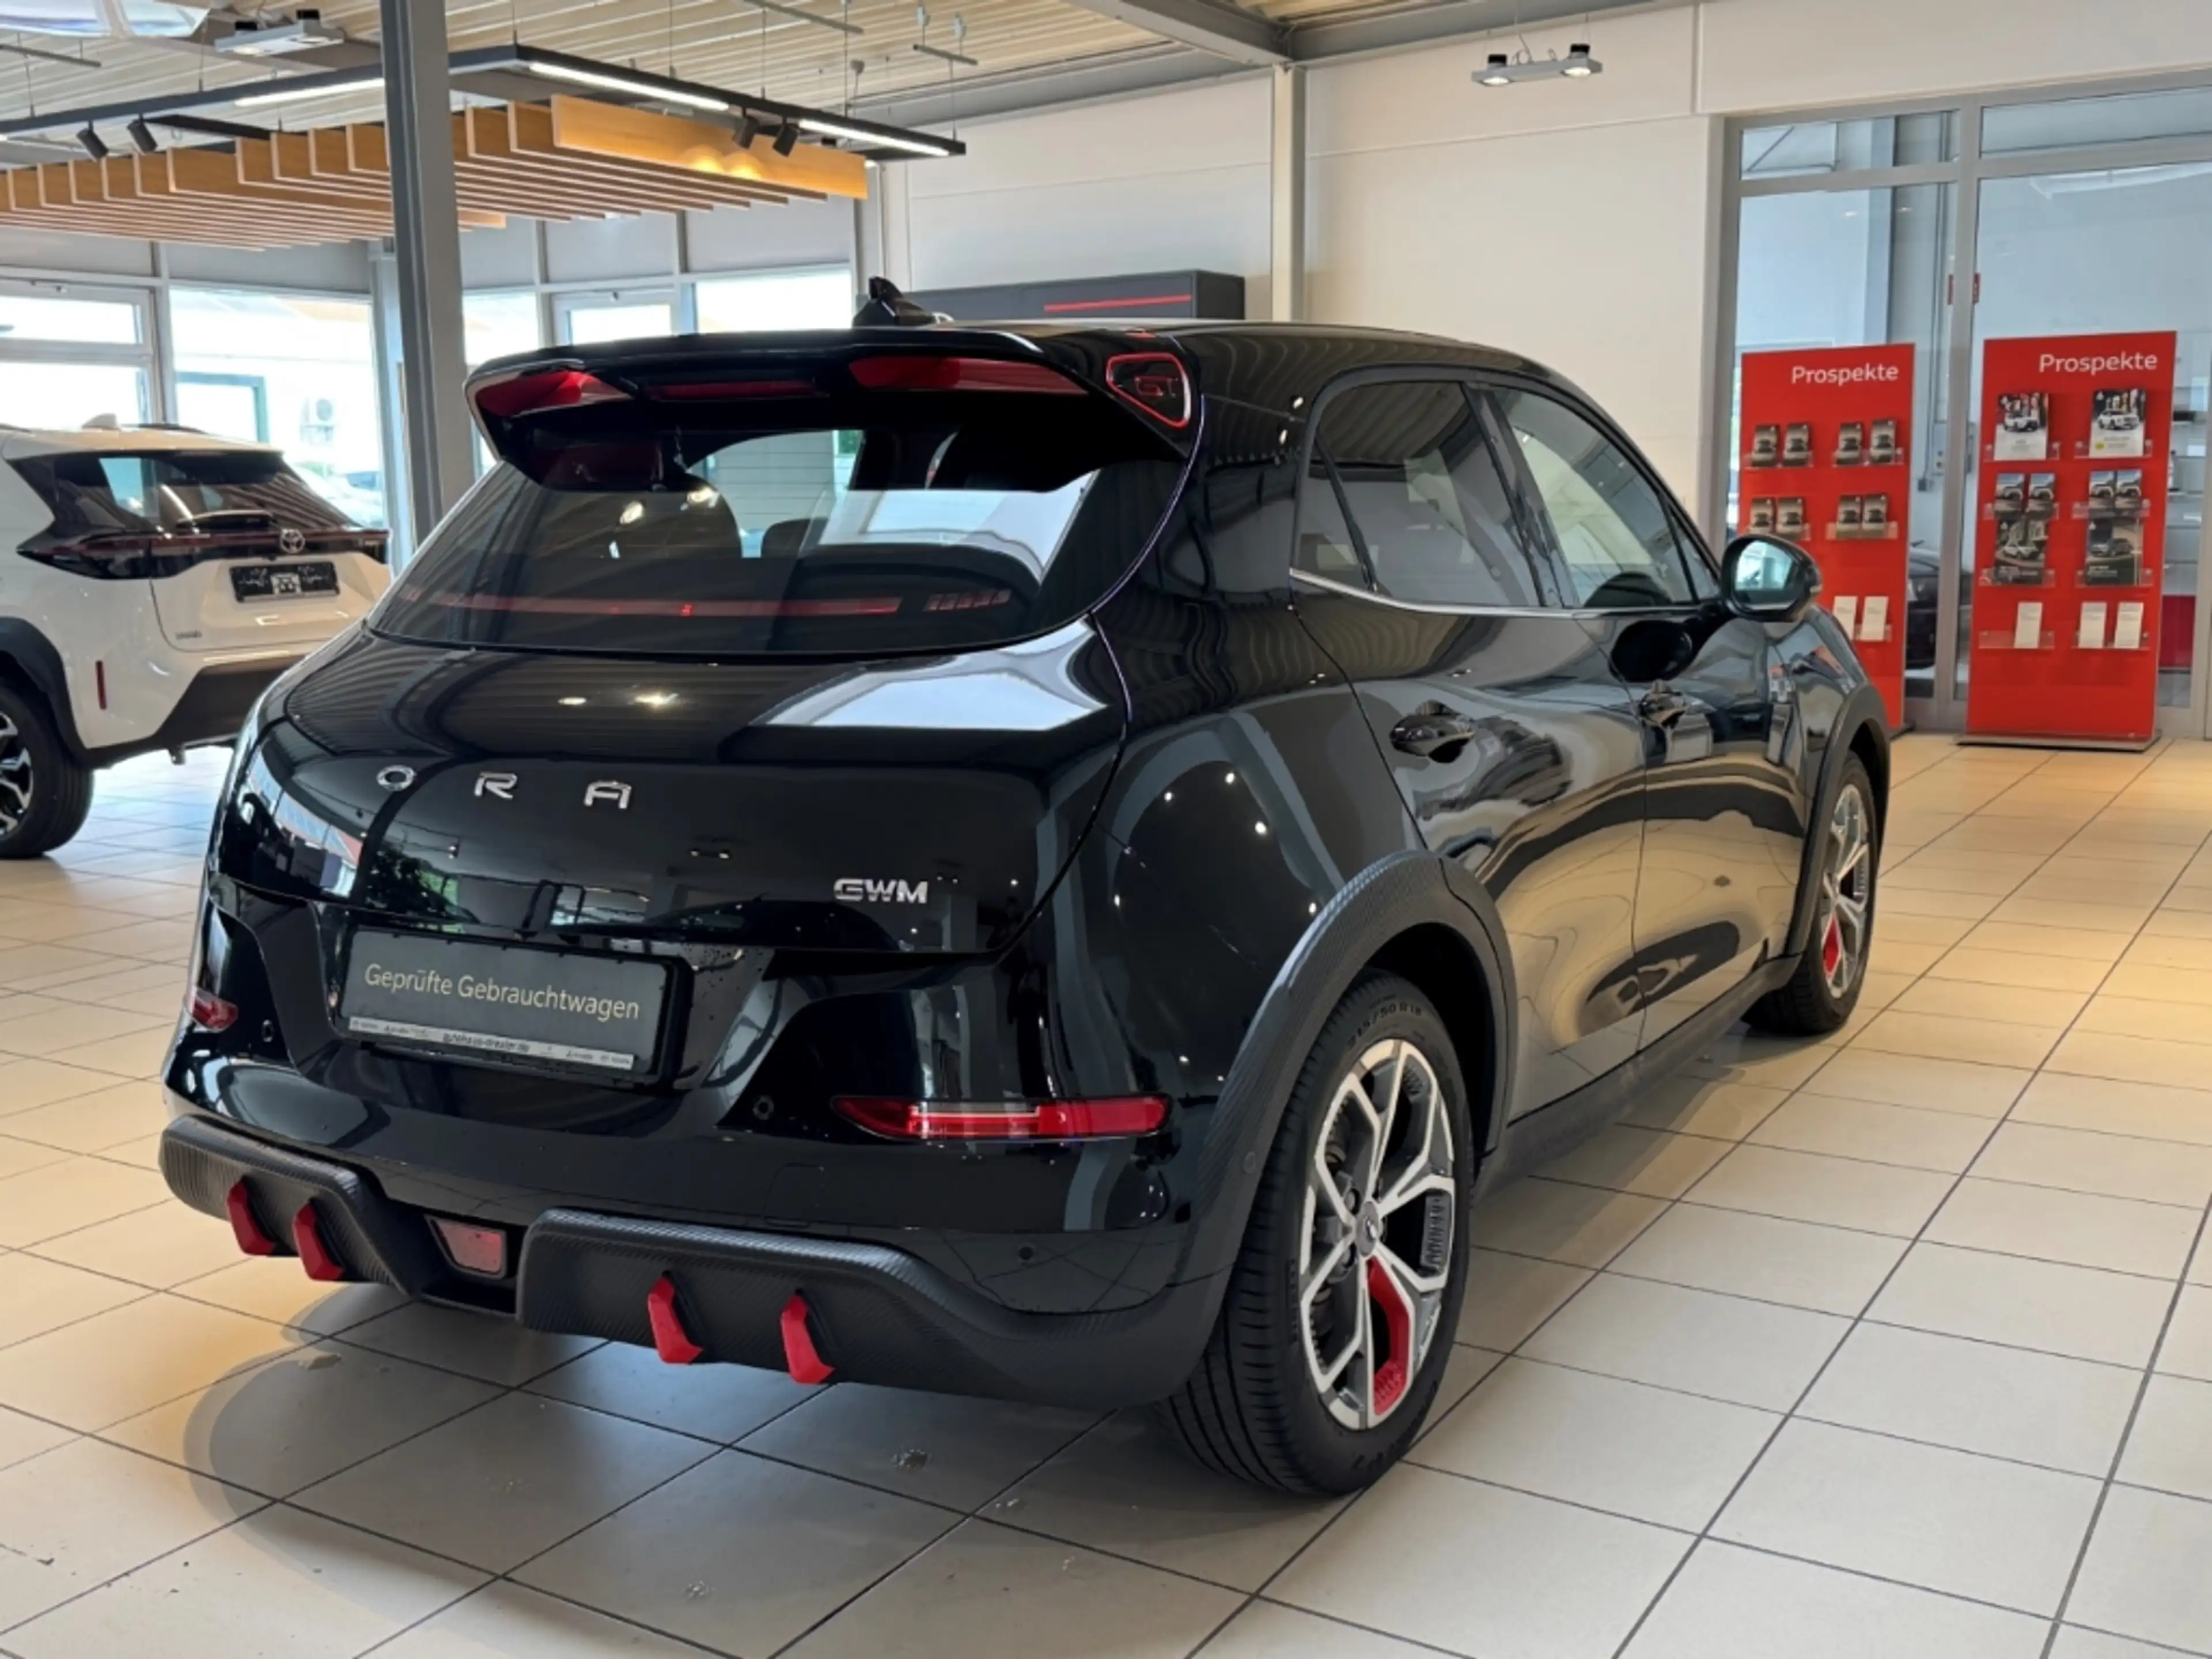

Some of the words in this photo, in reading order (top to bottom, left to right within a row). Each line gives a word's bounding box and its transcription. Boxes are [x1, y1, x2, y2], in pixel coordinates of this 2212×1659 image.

[1791, 363, 1900, 385] Prospekte
[2039, 352, 2158, 374] Prospekte
[376, 766, 632, 809] ORA
[834, 878, 928, 903] GWM
[365, 964, 452, 995] Geprüfte
[457, 975, 639, 1022] Gebrauchtwagen
